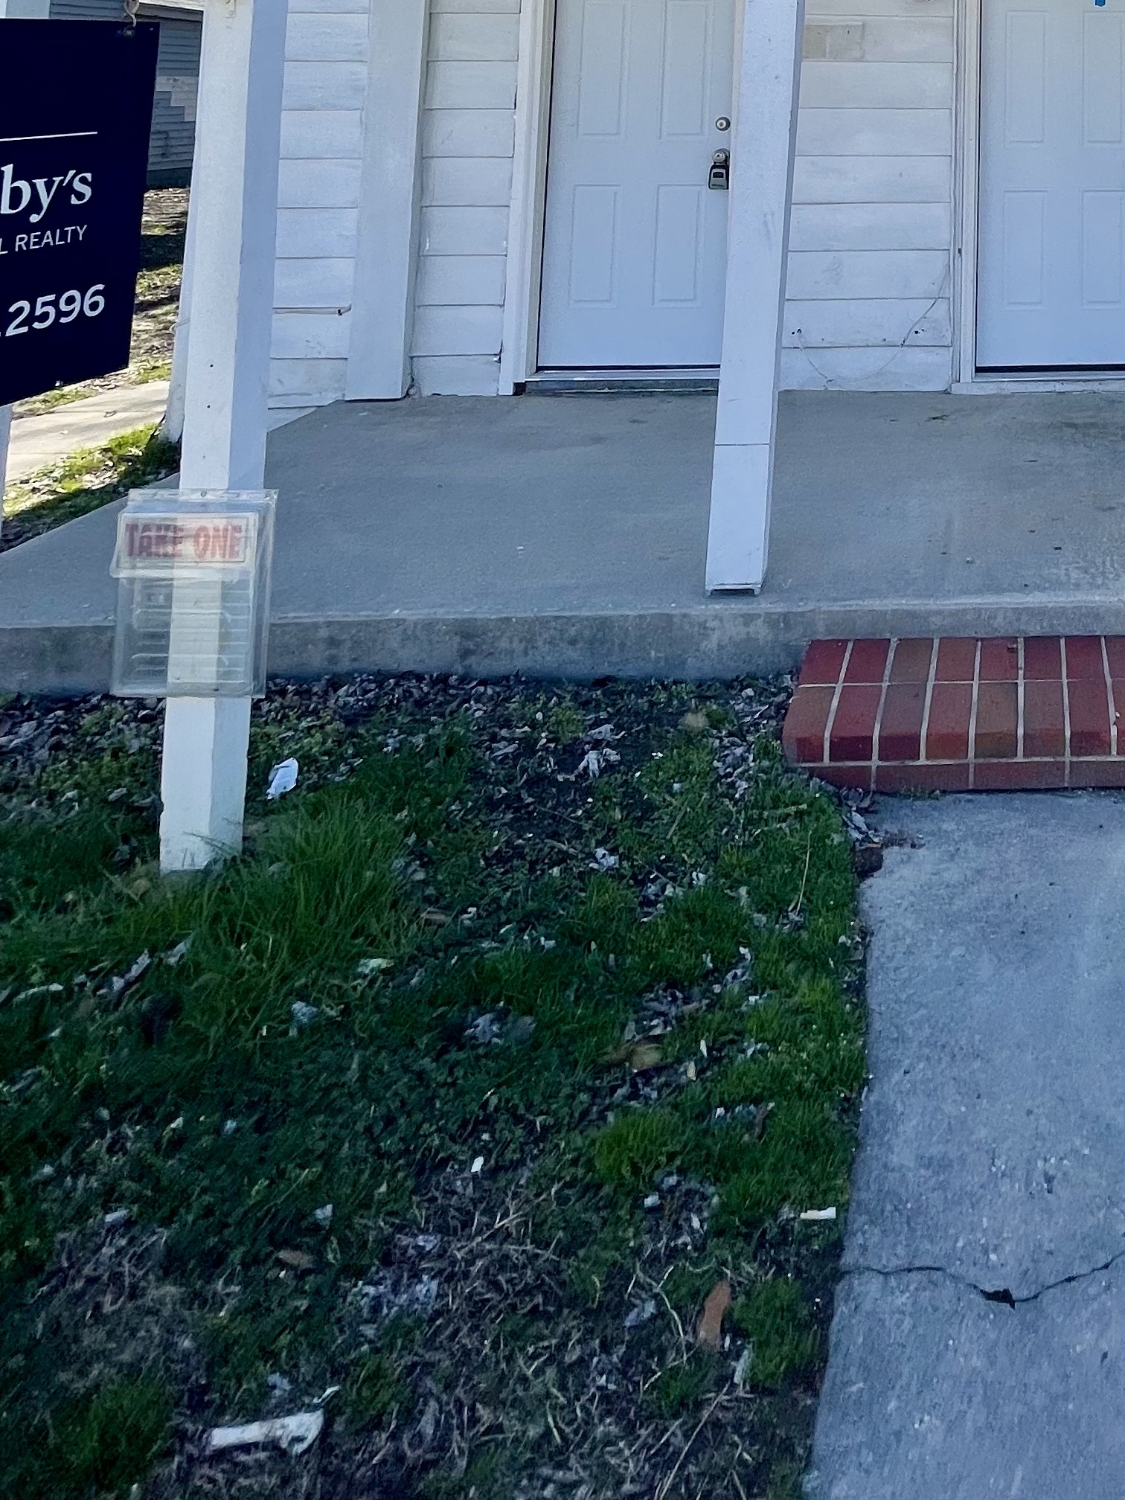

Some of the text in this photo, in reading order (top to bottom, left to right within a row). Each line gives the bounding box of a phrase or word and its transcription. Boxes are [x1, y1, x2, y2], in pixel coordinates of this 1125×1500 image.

[15, 224, 88, 252] REALTY
[125, 523, 243, 560] TAKE ONE
